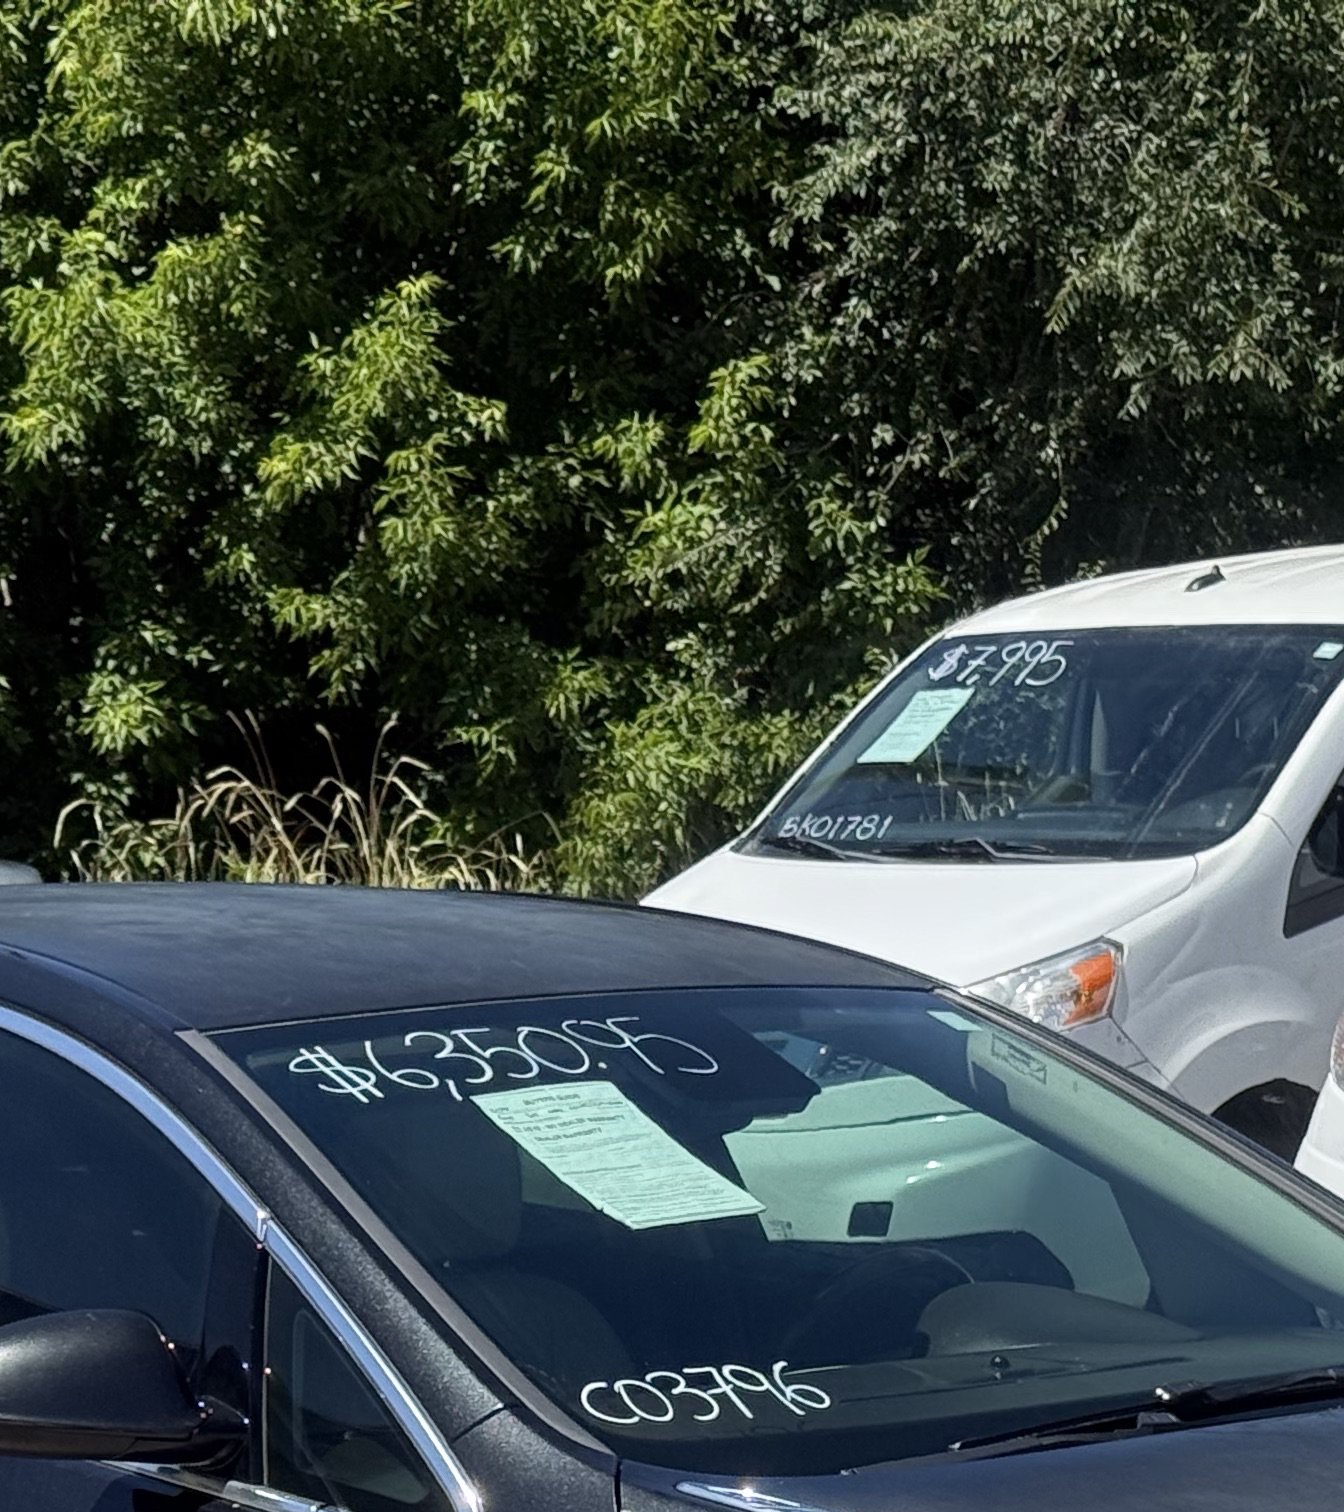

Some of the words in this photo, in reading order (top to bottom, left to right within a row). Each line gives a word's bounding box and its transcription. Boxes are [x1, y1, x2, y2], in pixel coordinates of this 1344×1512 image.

[927, 639, 1075, 687] $7,995
[288, 1016, 720, 1104] $6,350.95
[580, 1360, 832, 1425] C03796
